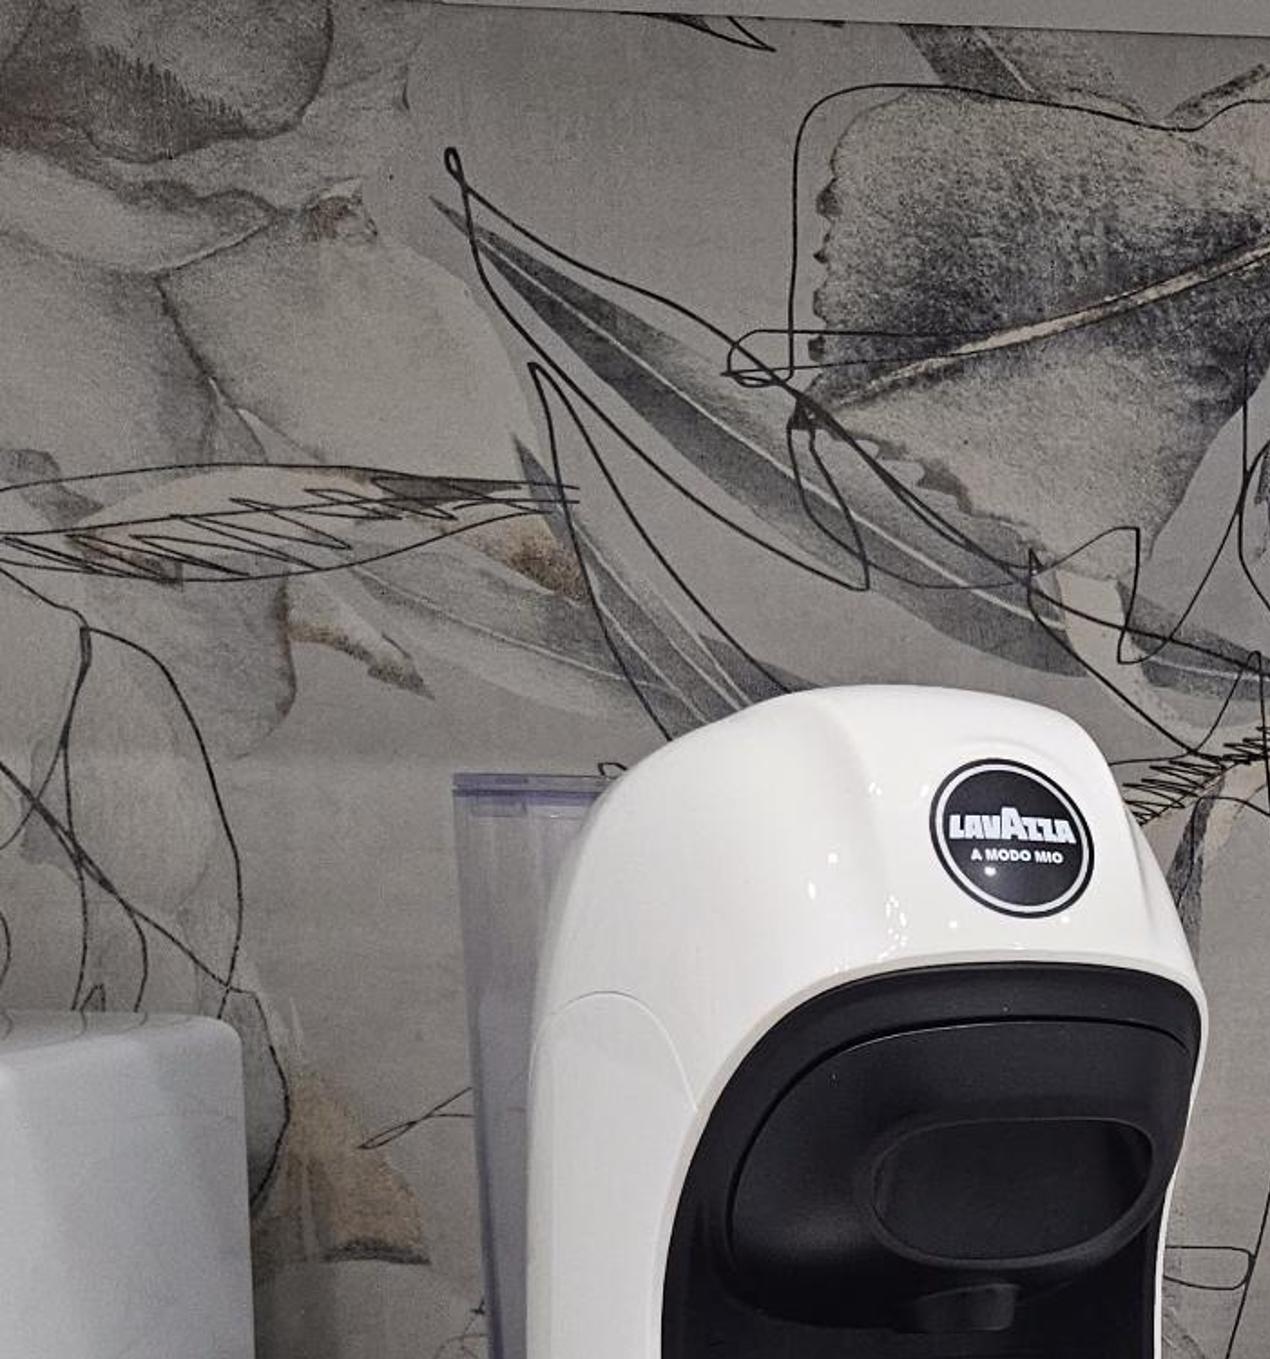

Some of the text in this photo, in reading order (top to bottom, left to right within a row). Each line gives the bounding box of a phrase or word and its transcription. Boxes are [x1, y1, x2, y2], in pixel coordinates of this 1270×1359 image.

[949, 806, 1077, 844] LAVAZZA
[970, 848, 1064, 864] A MODO MIO
